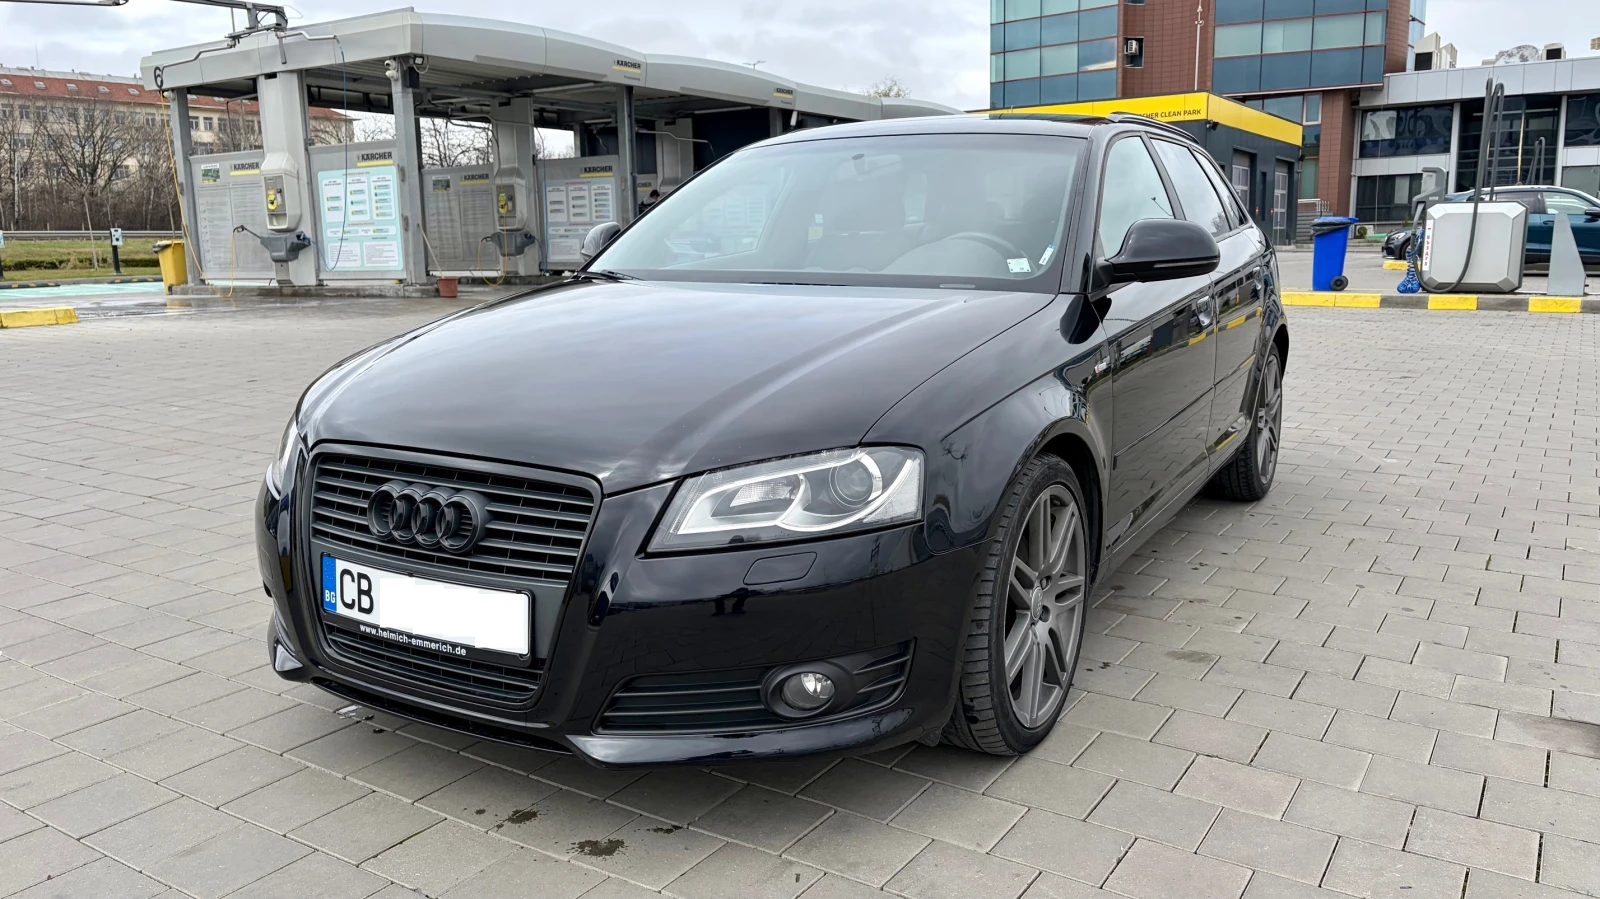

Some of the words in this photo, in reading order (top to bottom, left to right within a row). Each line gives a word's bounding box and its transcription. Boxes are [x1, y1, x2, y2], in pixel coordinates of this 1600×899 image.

[1160, 110, 1182, 118] CLEAN
[1183, 108, 1202, 116] PARK
[324, 589, 336, 604] BG
[339, 567, 375, 615] CB
[359, 623, 467, 656] www.helmich-emmerich.de
